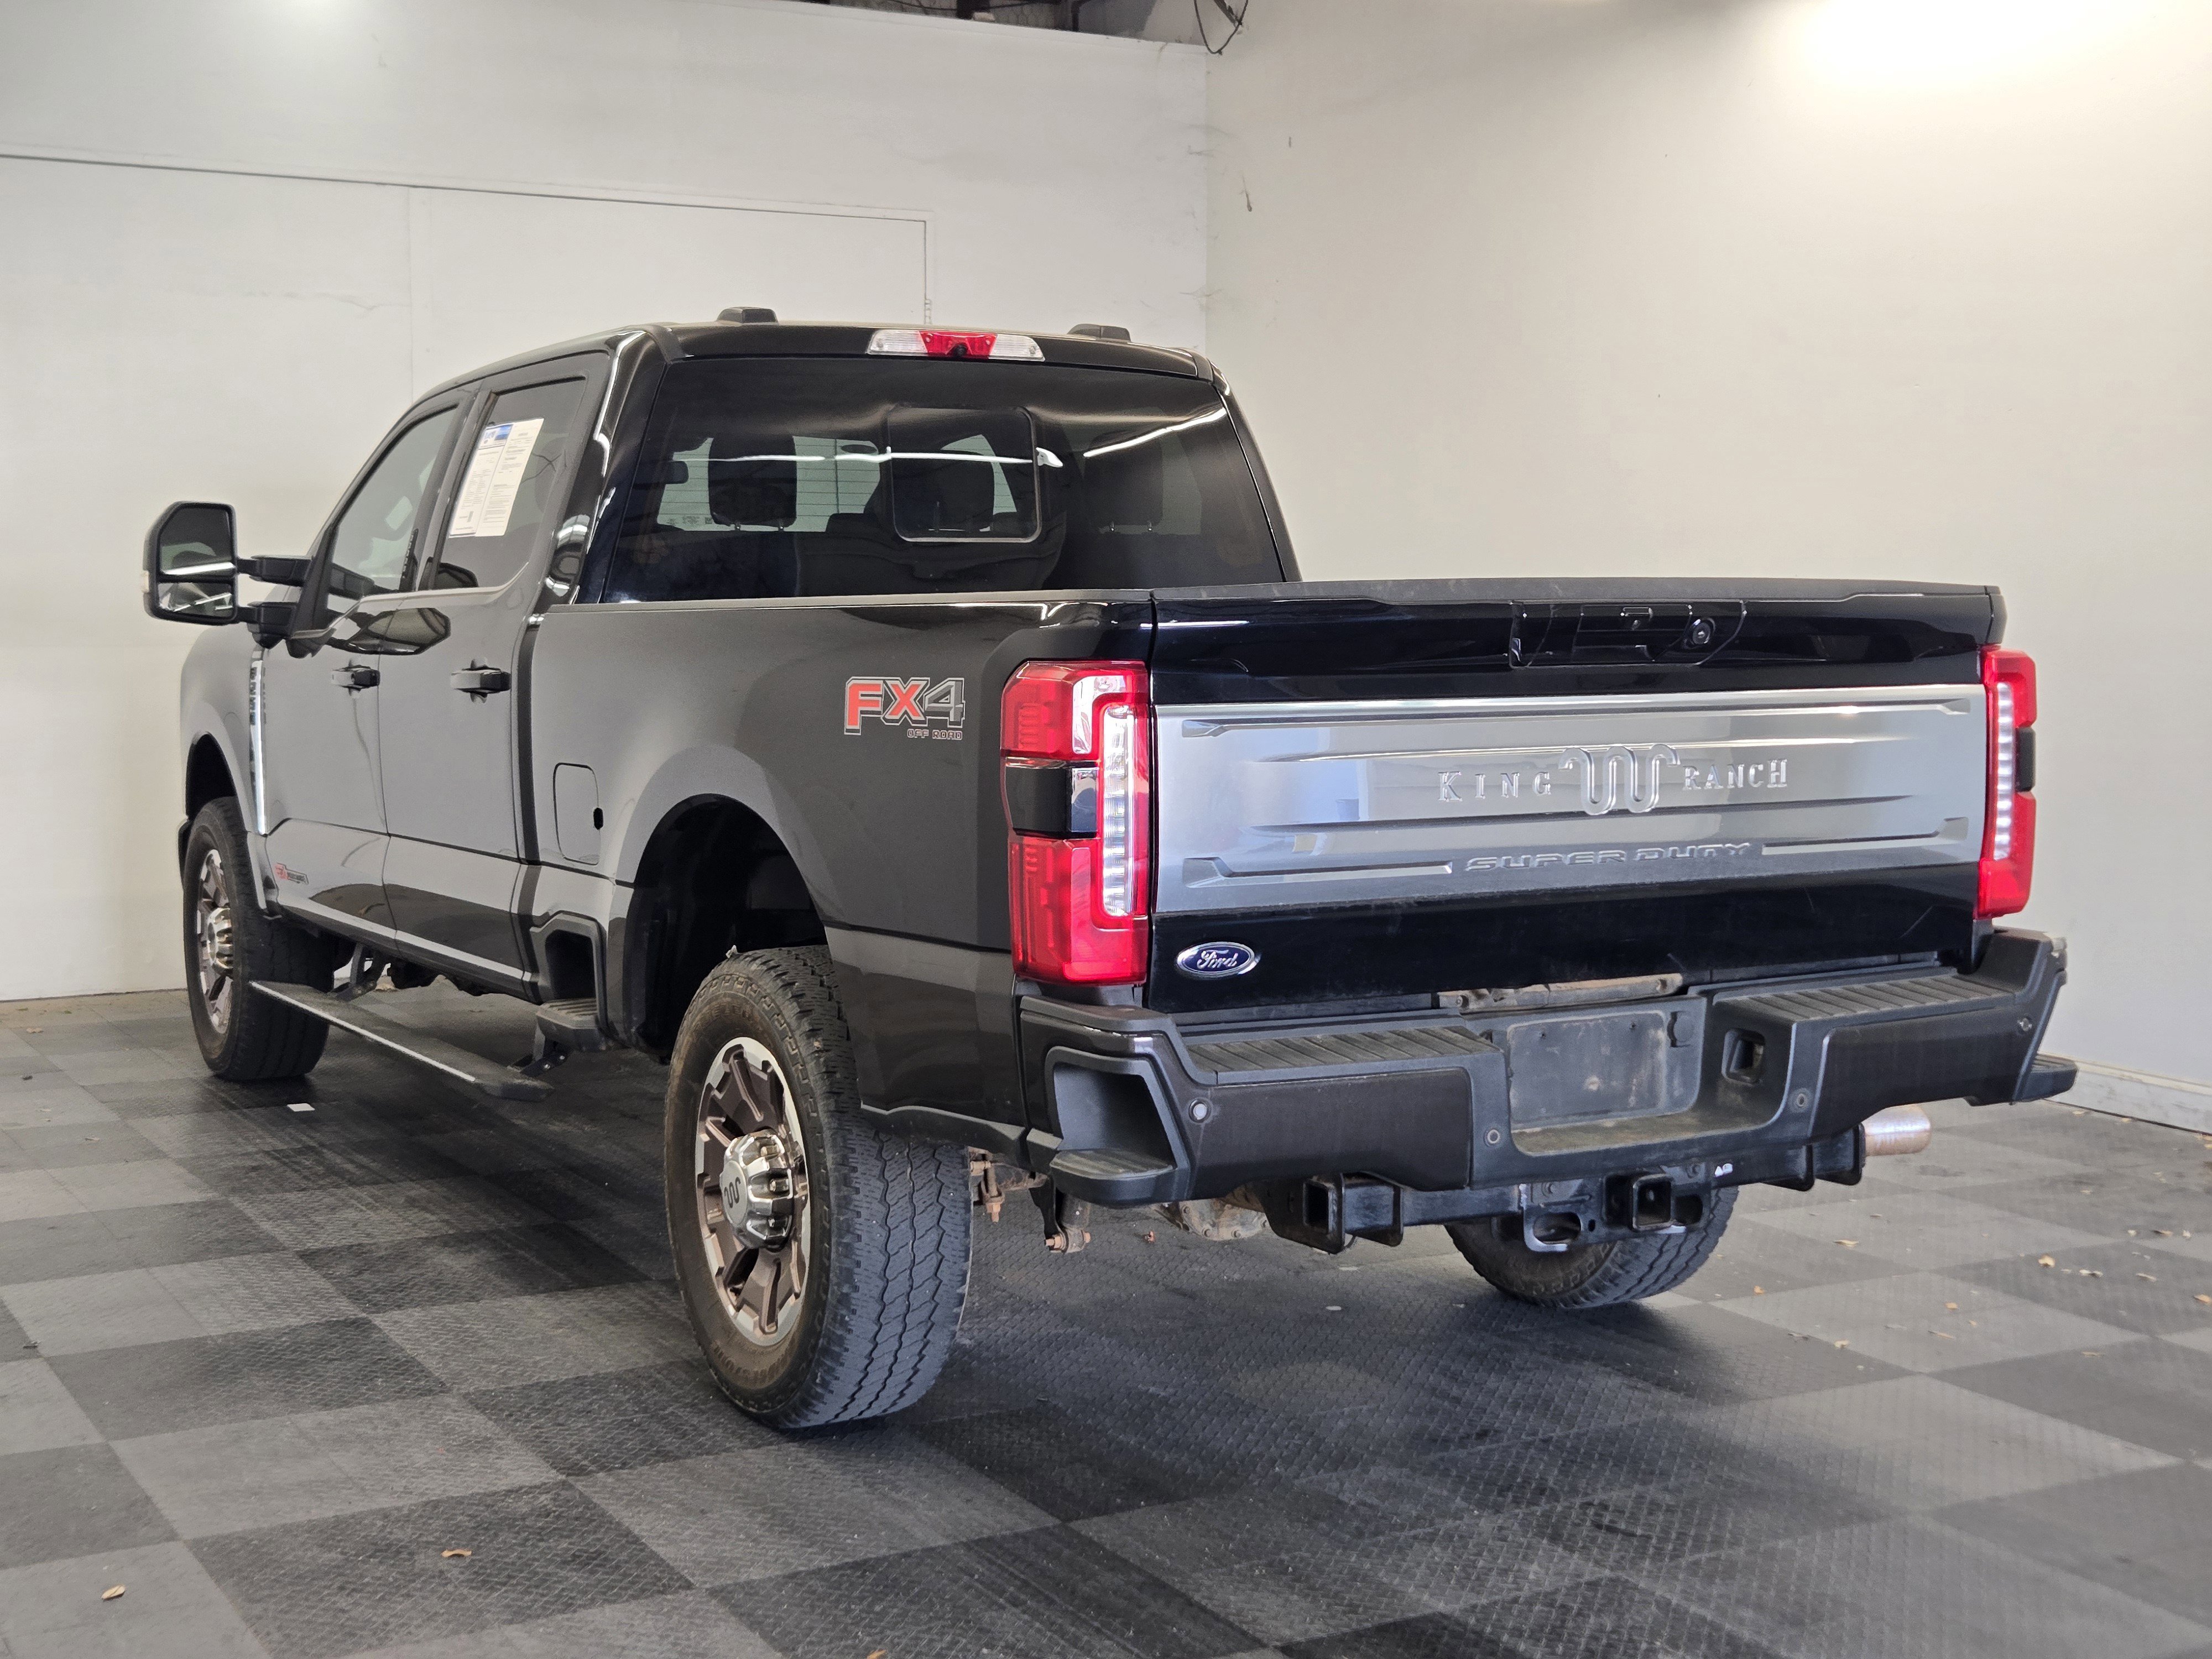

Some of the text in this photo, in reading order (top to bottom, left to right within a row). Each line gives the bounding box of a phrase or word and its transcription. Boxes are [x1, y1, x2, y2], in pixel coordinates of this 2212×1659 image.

[844, 676, 965, 735] FX4
[907, 728, 963, 740] OFF ROAD
[1438, 759, 1787, 802] KING RANCH
[1465, 842, 1750, 871] SUPER DUTY
[1197, 949, 1238, 968] Ford
